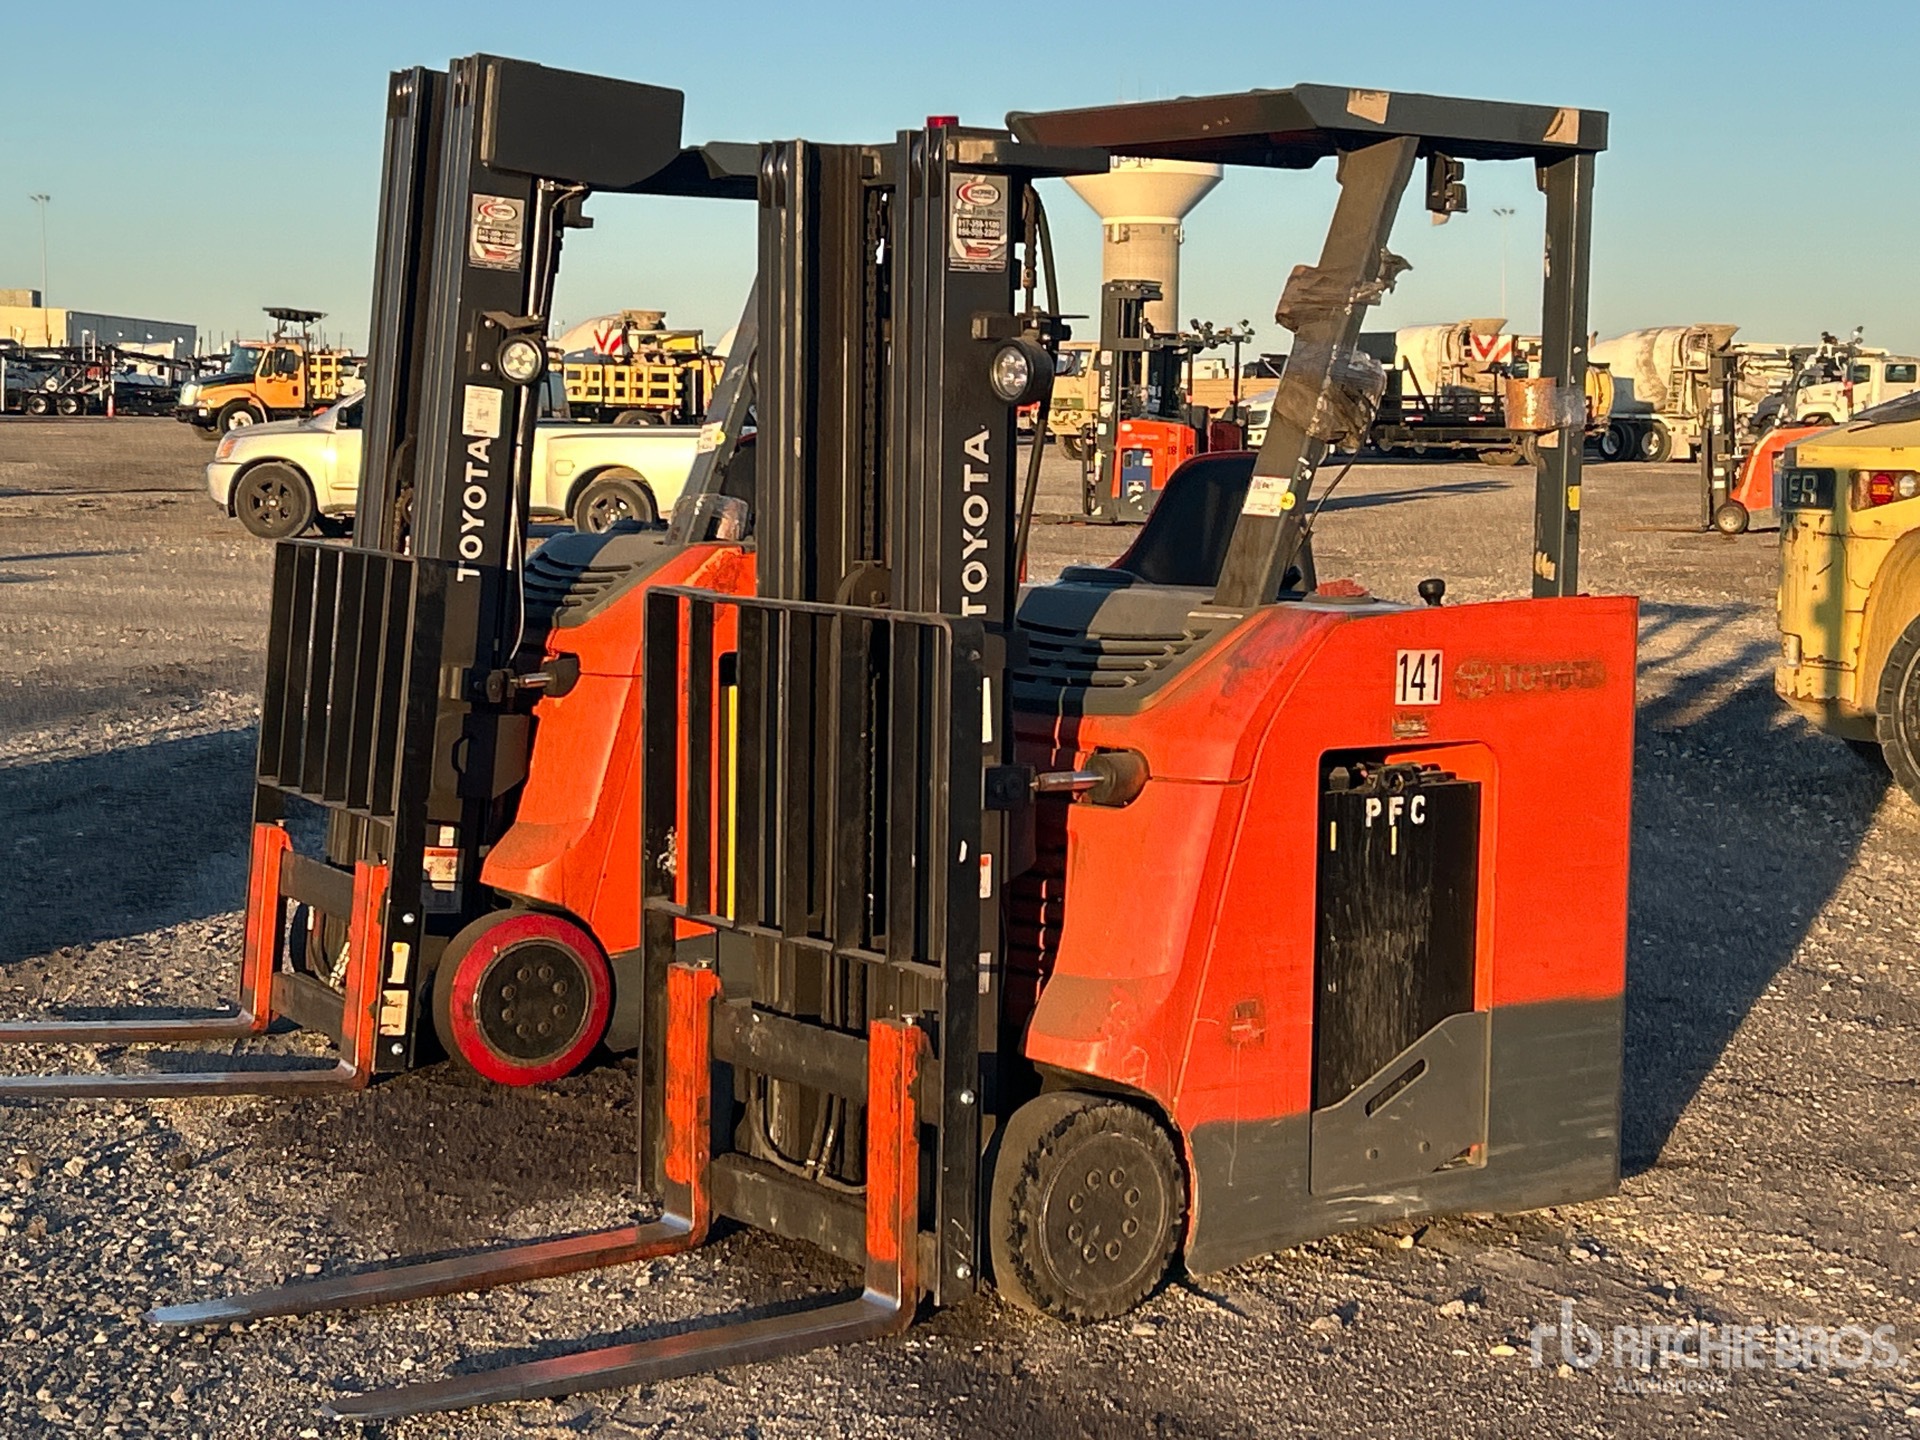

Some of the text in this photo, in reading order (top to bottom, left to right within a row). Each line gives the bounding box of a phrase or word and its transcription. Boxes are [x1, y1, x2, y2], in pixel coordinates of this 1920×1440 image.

[457, 439, 491, 582] TOYOTA
[962, 429, 990, 617] TOYOTA
[1399, 653, 1441, 702] 141
